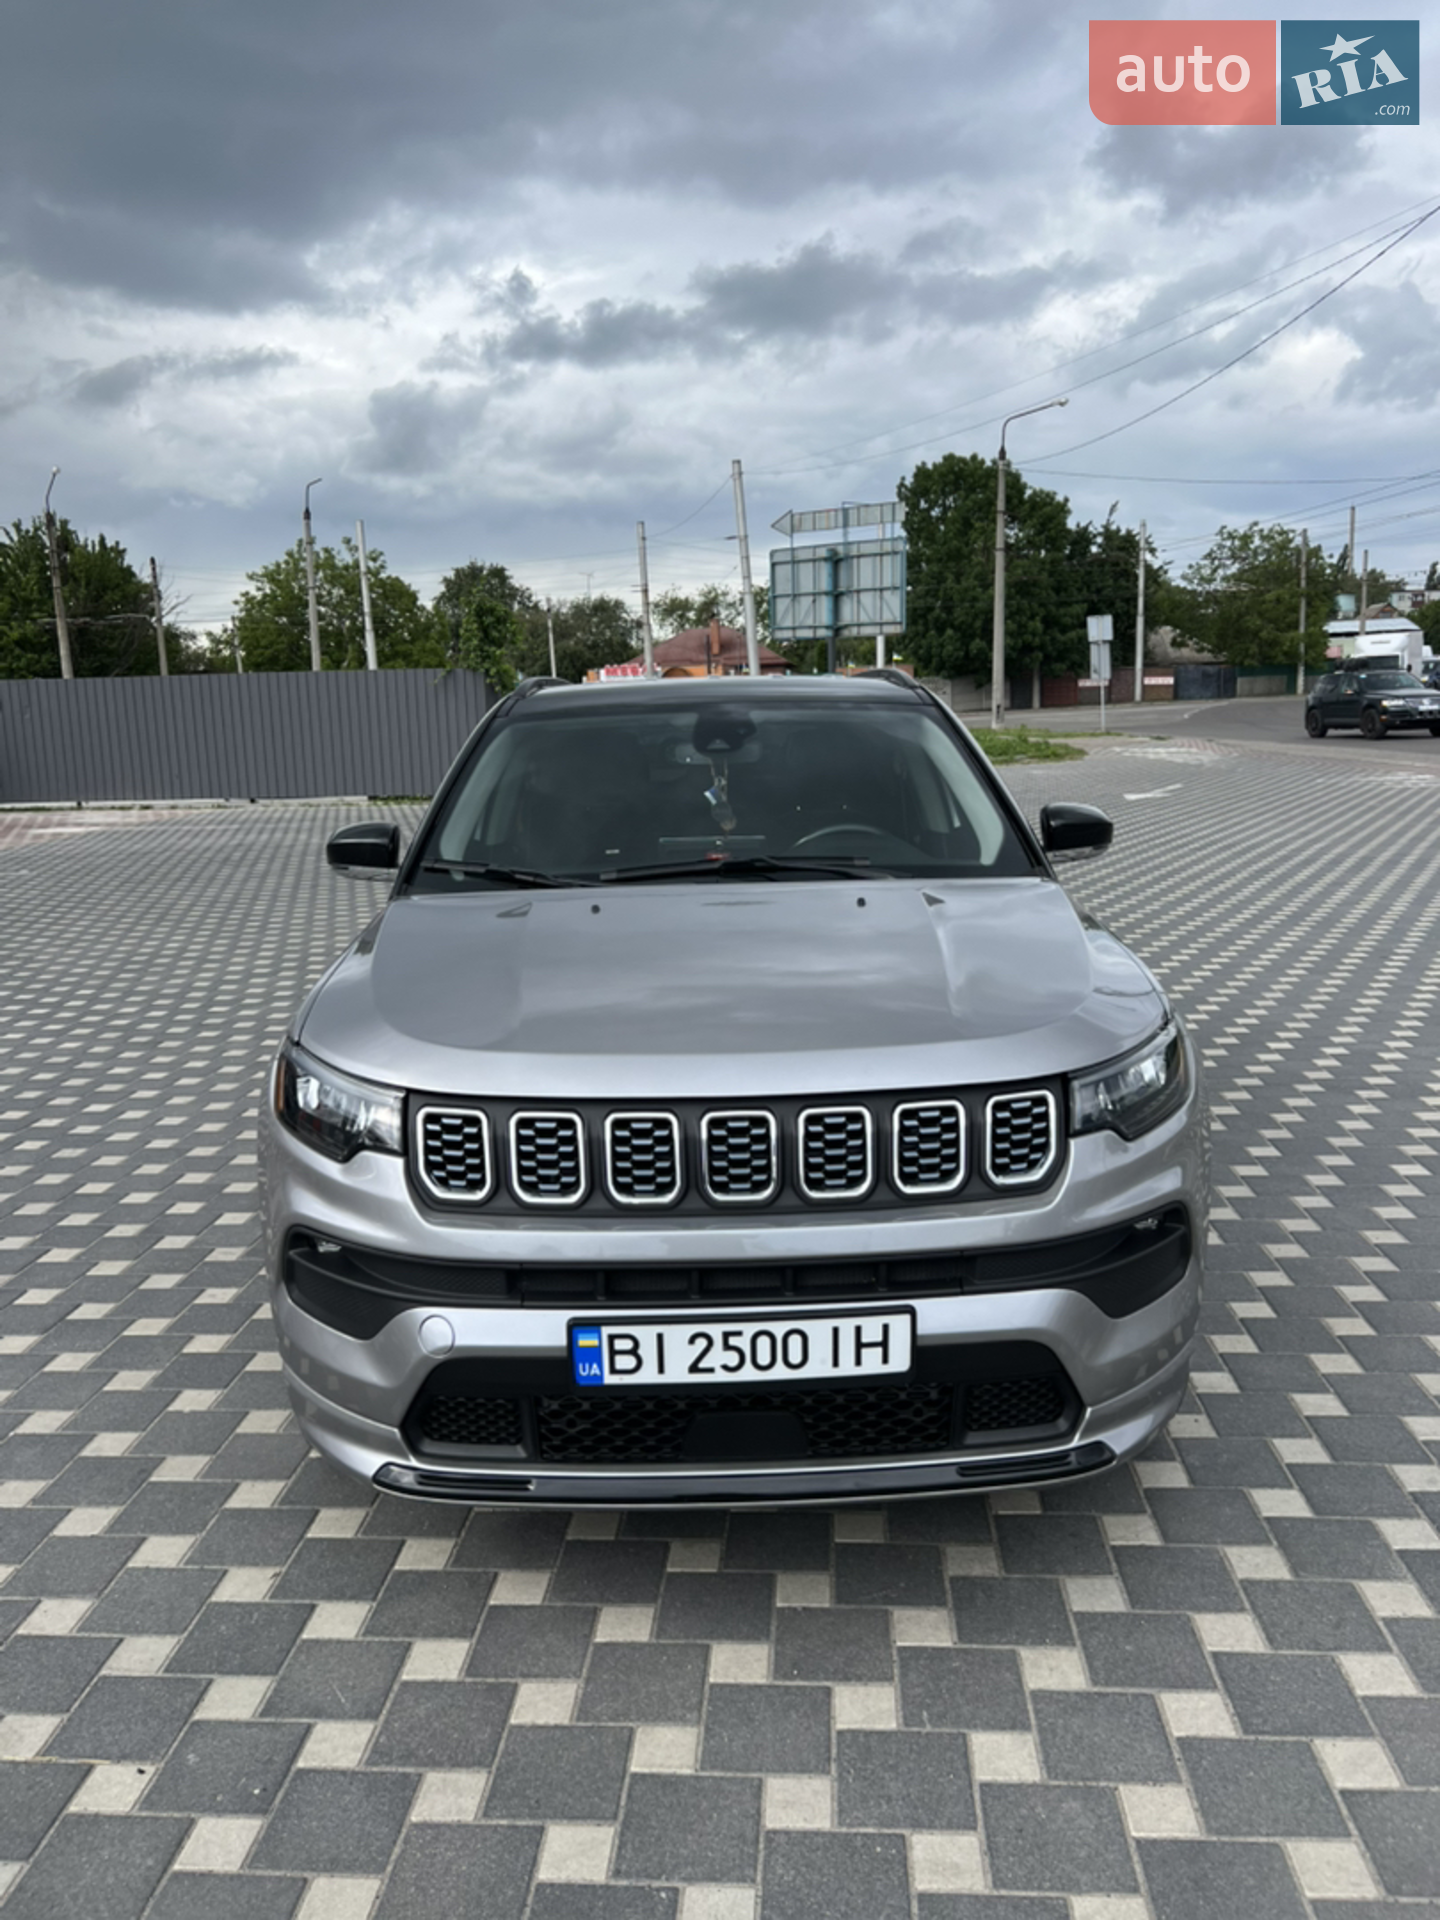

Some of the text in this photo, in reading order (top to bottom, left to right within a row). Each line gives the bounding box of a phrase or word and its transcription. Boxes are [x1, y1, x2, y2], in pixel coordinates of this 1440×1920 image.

[607, 1323, 890, 1376] BI 2500 IH
[578, 1363, 601, 1376] UA
